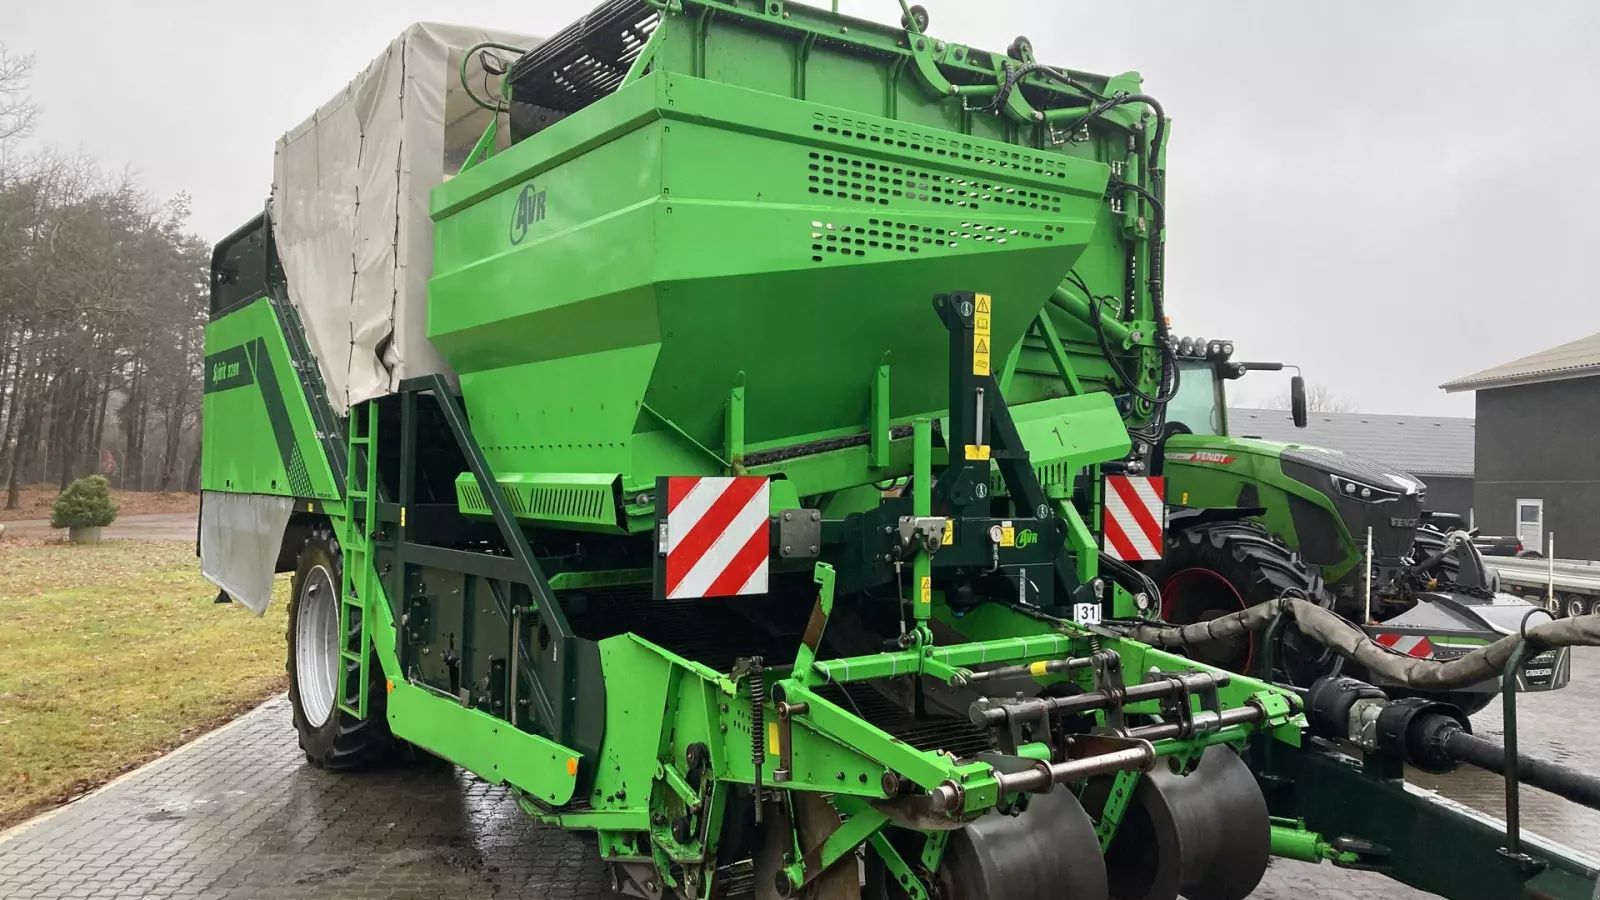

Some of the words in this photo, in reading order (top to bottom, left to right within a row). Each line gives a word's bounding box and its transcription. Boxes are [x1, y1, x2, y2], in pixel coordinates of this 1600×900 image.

[510, 183, 546, 245] AVR
[1196, 452, 1228, 463] FENDT
[1015, 529, 1038, 549] AVR
[1081, 605, 1095, 620] 31
